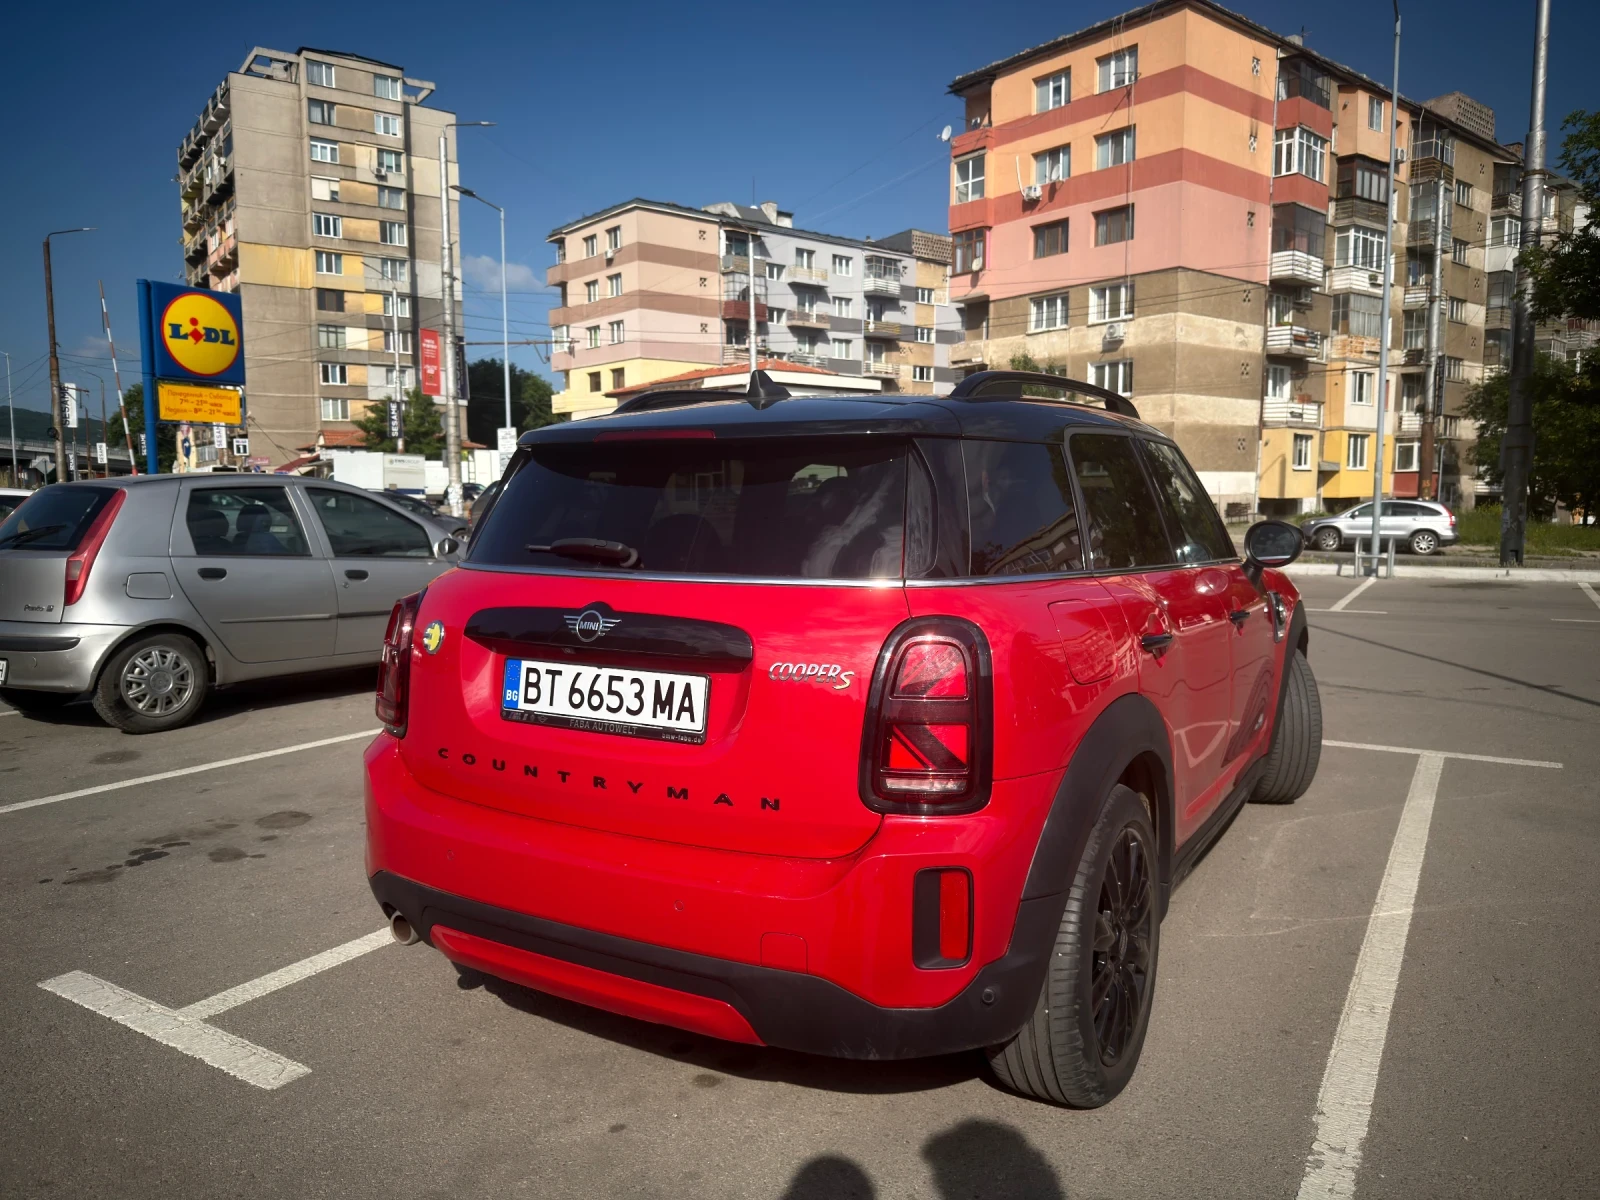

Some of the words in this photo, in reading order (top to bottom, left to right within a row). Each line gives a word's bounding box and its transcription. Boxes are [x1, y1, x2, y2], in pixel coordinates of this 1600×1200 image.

[390, 402, 399, 437] SESAME
[579, 621, 599, 631] MINI
[768, 662, 843, 684] COOPER
[832, 671, 855, 690] S
[506, 690, 519, 701] BG
[524, 667, 562, 706] BT
[568, 672, 645, 716] 6653
[652, 680, 695, 724] MA
[569, 719, 590, 729] FABA
[592, 721, 638, 735] AUTOWELT
[438, 747, 781, 812] COUNTRYMAN
